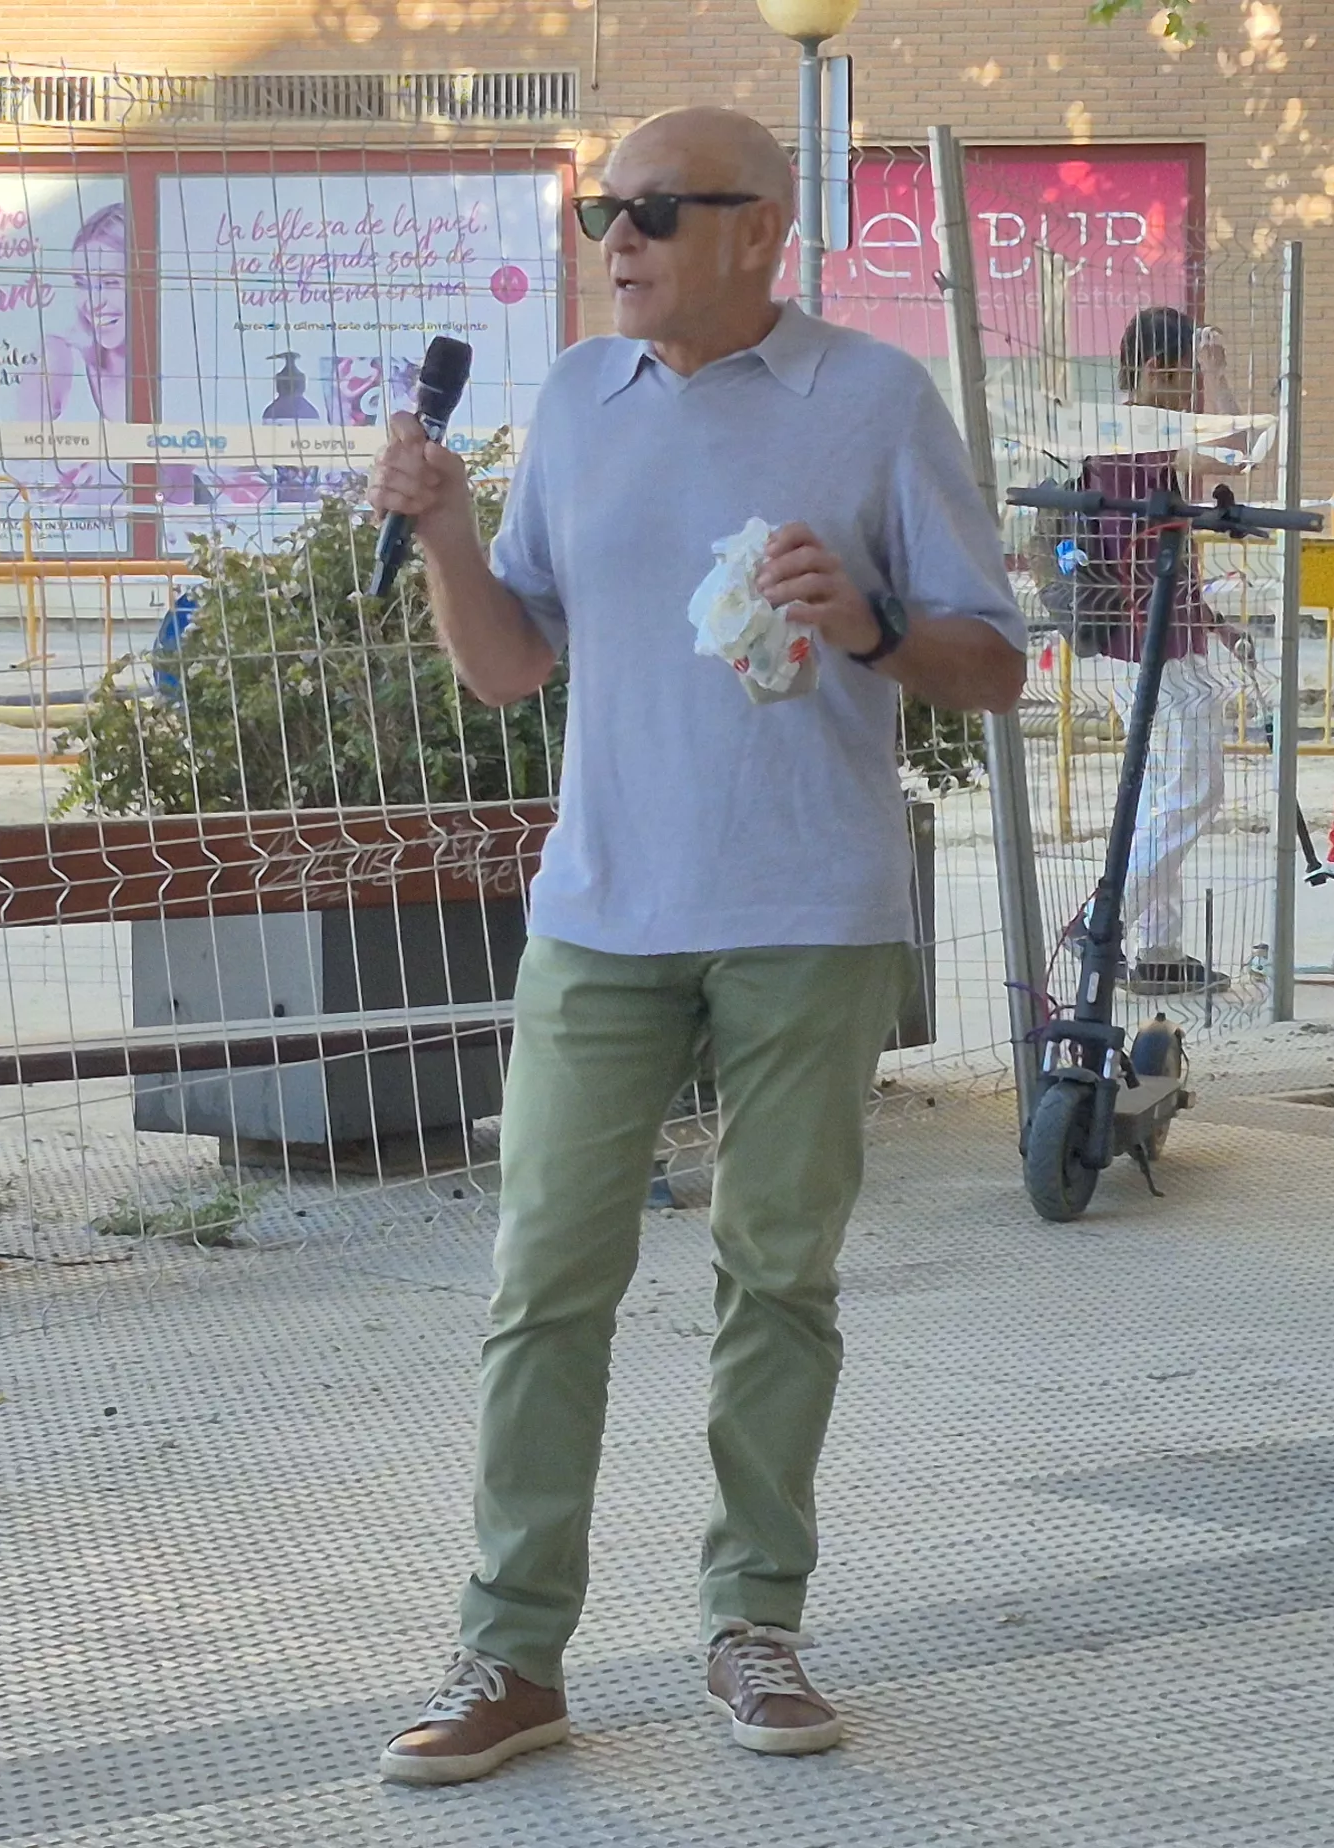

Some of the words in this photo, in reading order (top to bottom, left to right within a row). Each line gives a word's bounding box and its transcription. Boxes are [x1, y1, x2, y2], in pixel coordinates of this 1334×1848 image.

[217, 212, 246, 246] La
[252, 206, 349, 248] belleza
[354, 203, 386, 236] de
[393, 203, 421, 236] la
[229, 245, 261, 276] no
[446, 232, 475, 265] de
[240, 285, 294, 308] una
